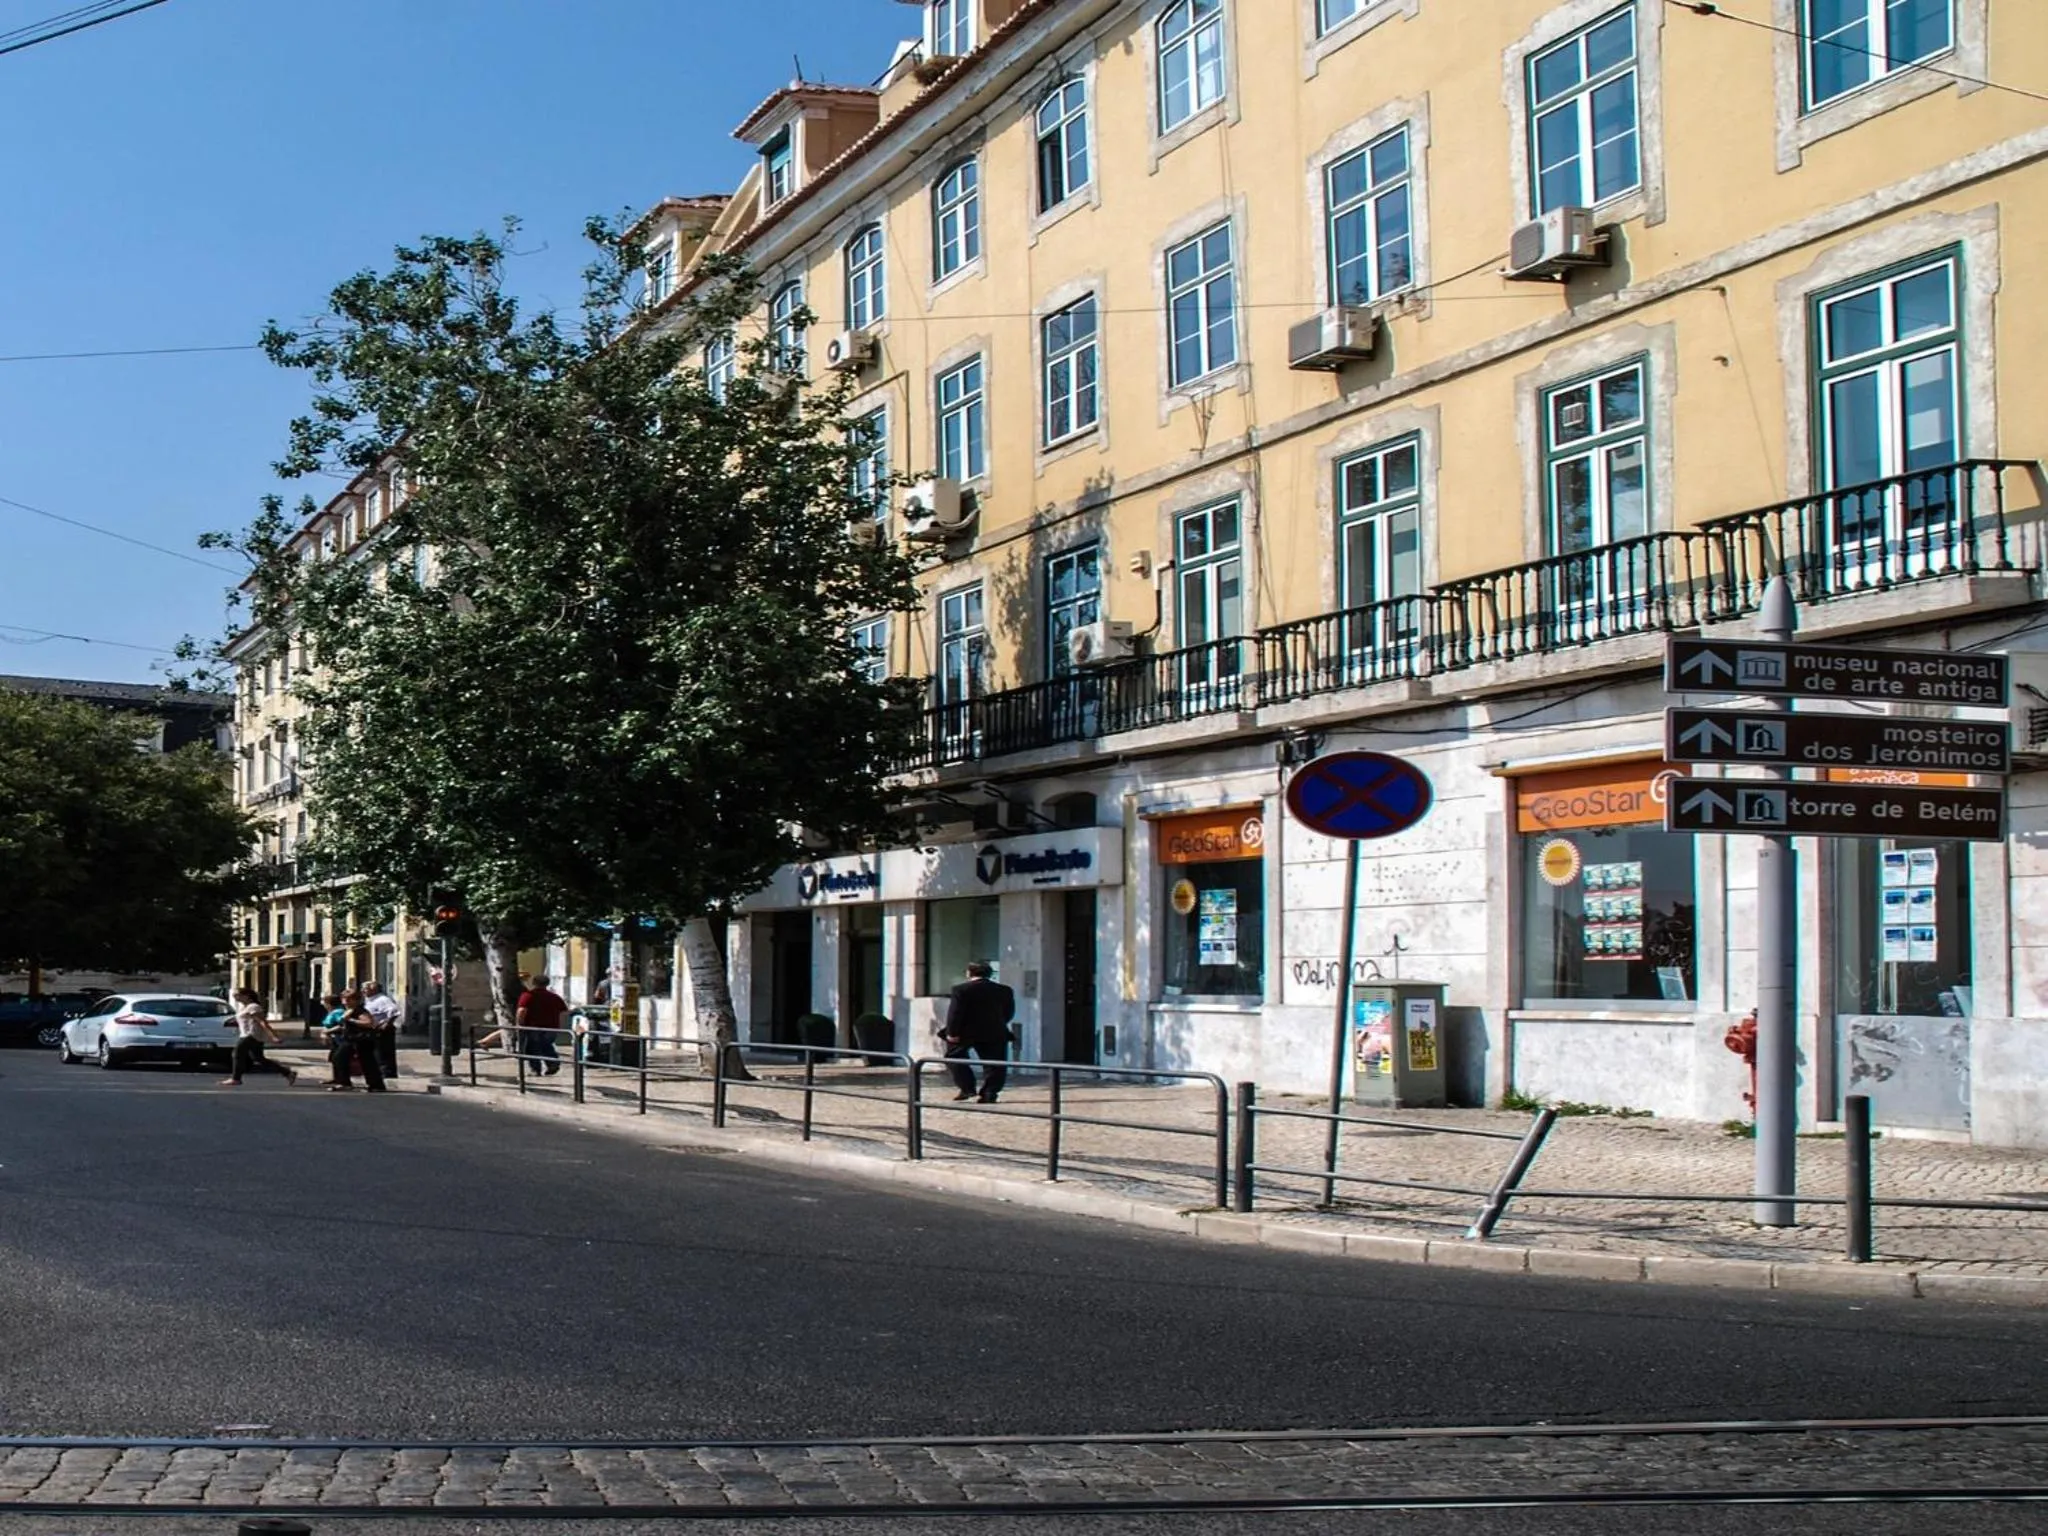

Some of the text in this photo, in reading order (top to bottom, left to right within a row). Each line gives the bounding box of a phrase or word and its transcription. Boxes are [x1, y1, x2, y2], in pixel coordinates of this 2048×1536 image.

[1793, 655, 1999, 679] museu nacional
[1803, 672, 1998, 702] de arte antiga
[1883, 727, 2001, 747] mosteiro
[1802, 741, 2001, 767] dos Jerónimos
[1531, 789, 1648, 821] GeoStar
[1789, 798, 1997, 822] torre de Belém
[1169, 831, 1239, 853] GeoStar
